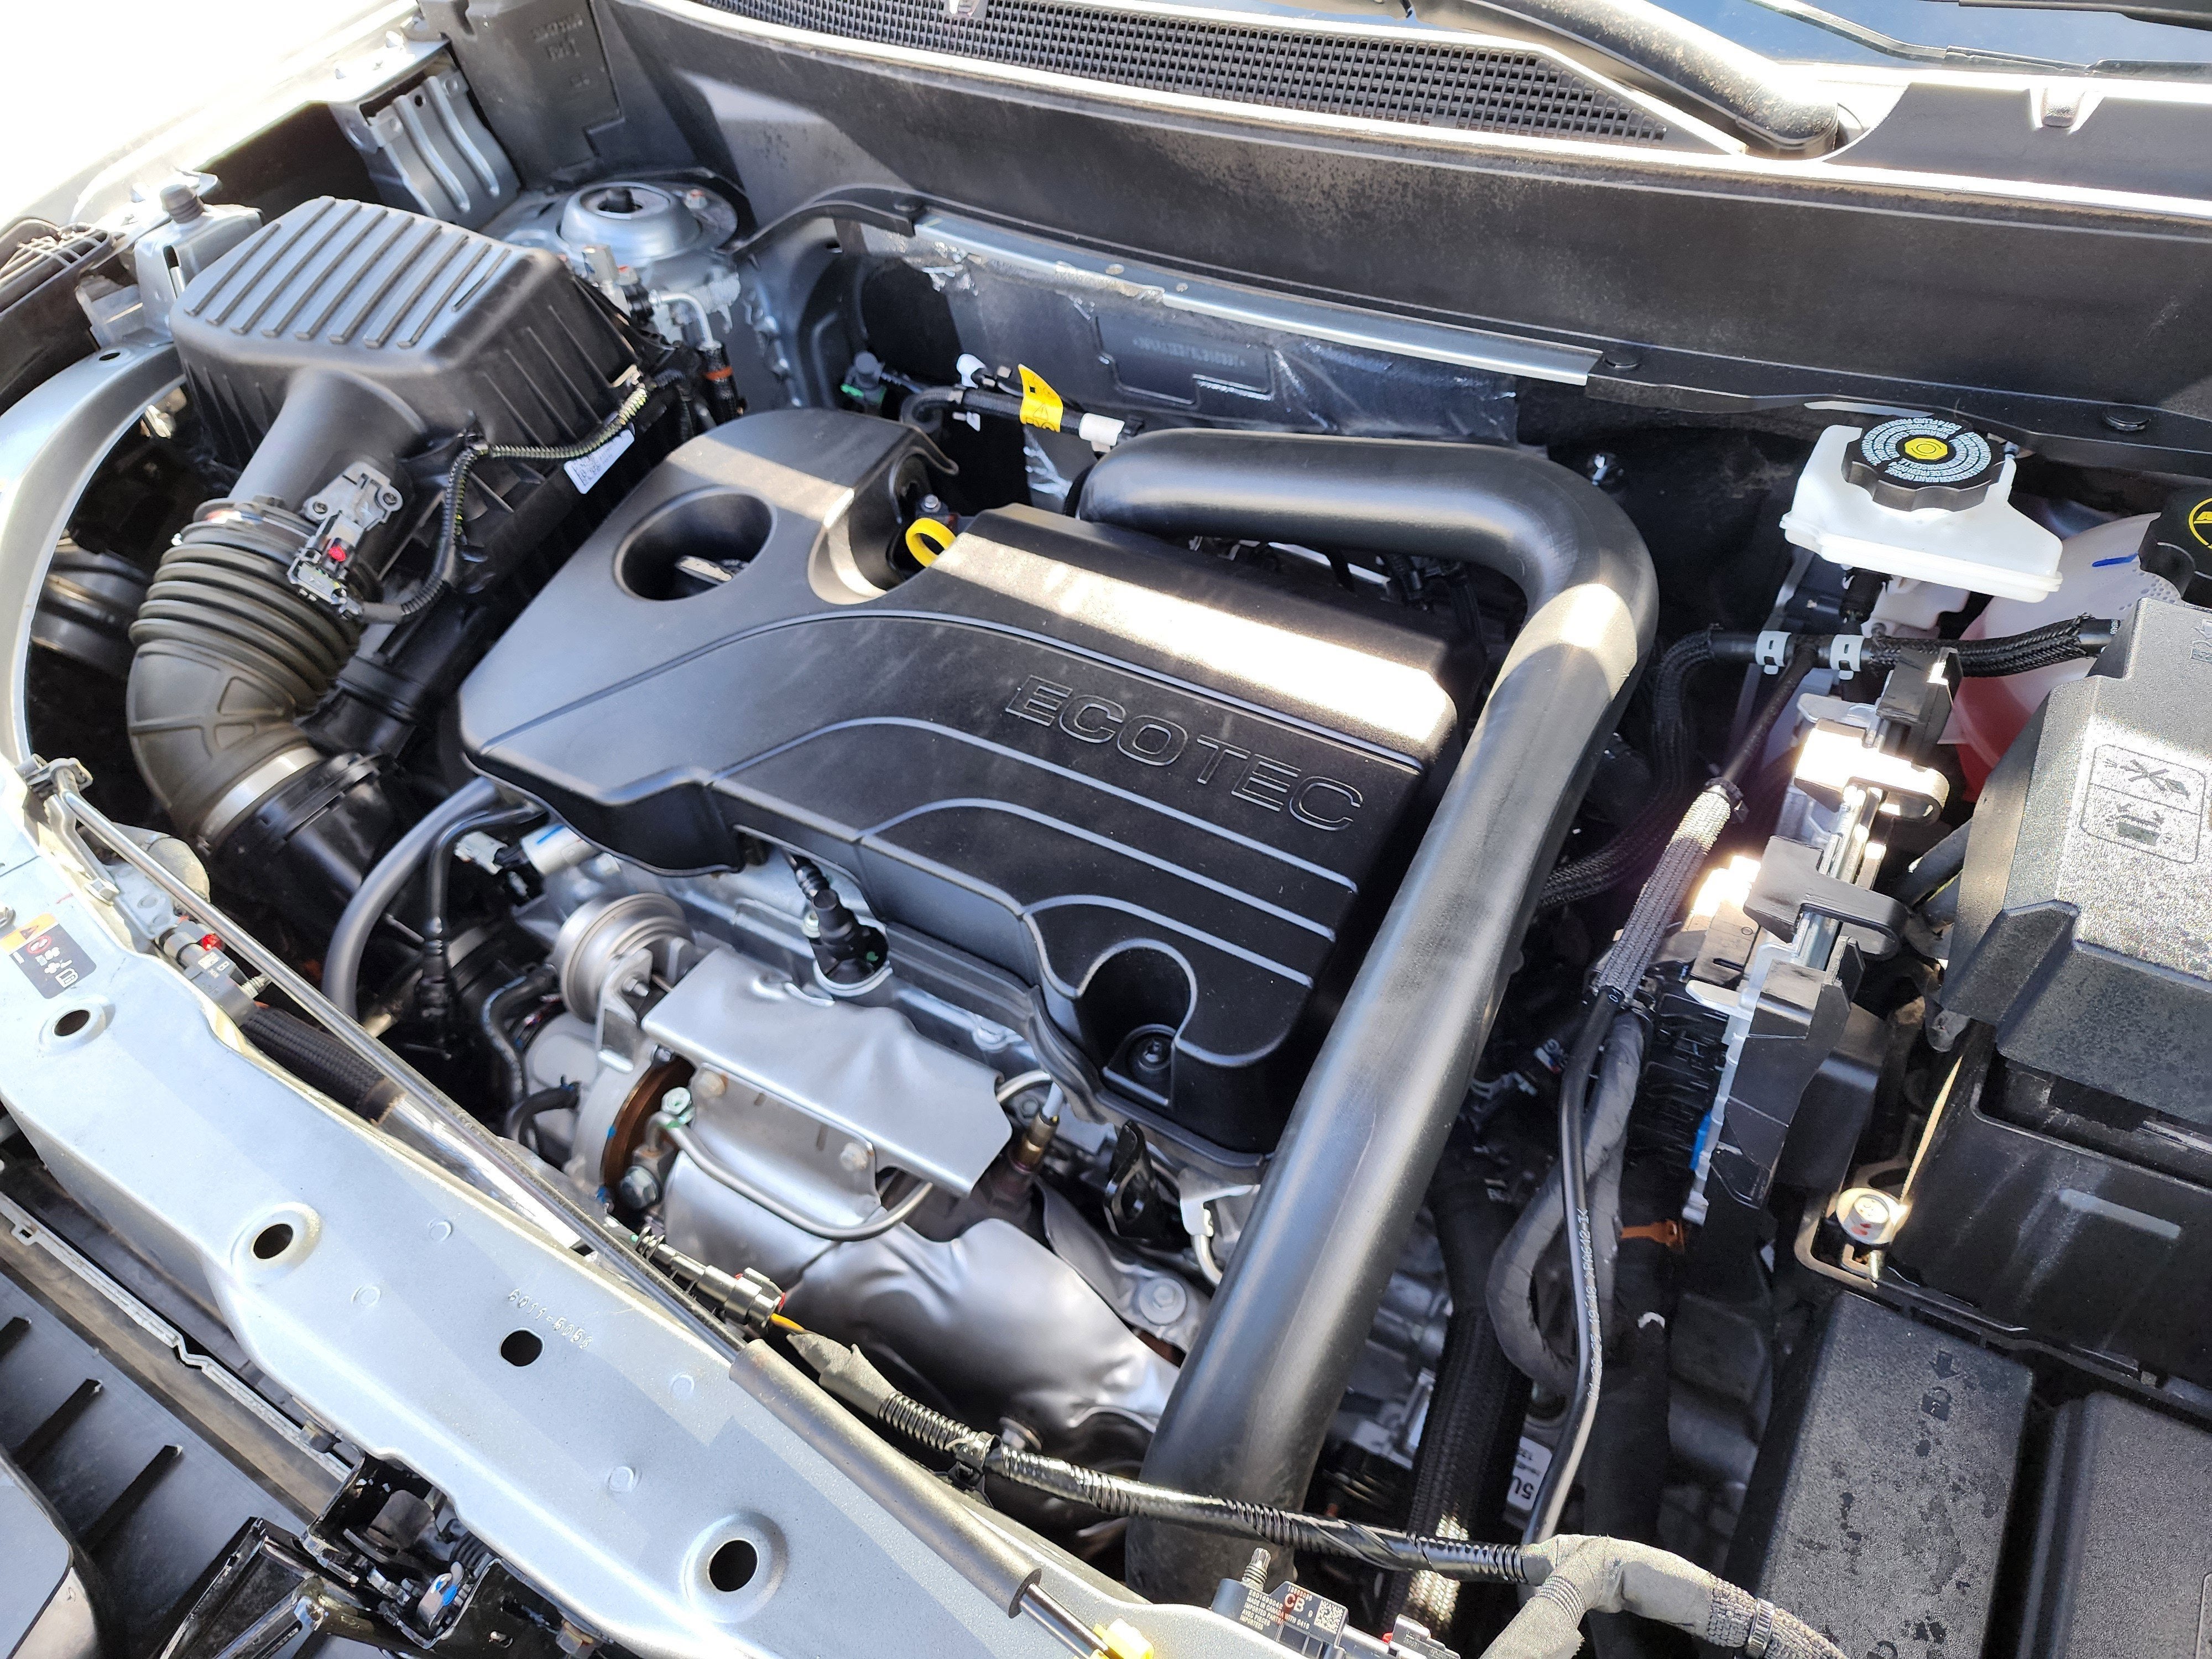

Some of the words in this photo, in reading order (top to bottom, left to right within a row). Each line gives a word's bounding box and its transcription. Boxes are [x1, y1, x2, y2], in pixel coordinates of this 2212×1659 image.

[1887, 418, 1913, 426] FROM
[1942, 421, 1962, 431] DOT
[1864, 425, 1887, 440] SEALED
[1886, 431, 1909, 444] CLEAN
[1874, 450, 1891, 461] ONLY
[1885, 443, 1900, 458] FILLER
[1892, 463, 1909, 472] DOT
[1907, 468, 1929, 476] FREIN
[1004, 674, 1364, 832] ECOTEC
[1246, 1595, 1260, 1606] MADE
[1266, 1604, 1284, 1618] CANADA
[1284, 1612, 1297, 1623] WITH
[1285, 1593, 1305, 1612] CB
[1241, 1608, 1254, 1618] AVEC
[1254, 1614, 1271, 1626] PIECES
[1244, 1602, 1267, 1619] IMPORTED
[1240, 1614, 1264, 1630] IMPORTEES
